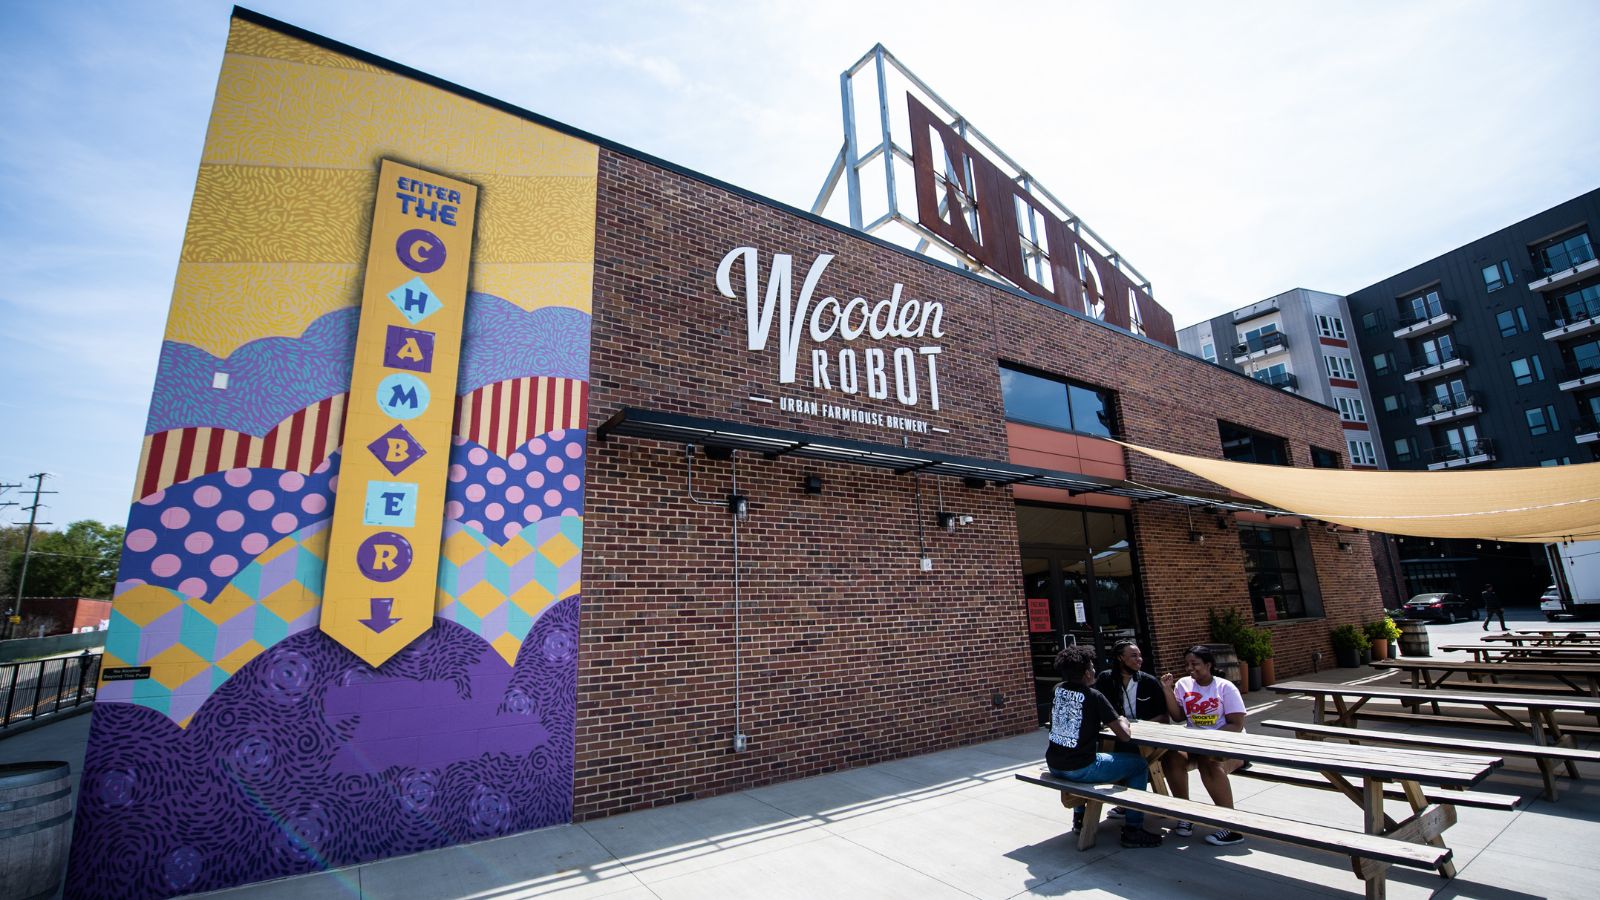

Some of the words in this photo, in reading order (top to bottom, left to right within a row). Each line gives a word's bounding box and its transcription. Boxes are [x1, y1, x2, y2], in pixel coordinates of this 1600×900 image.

[396, 175, 462, 206] ENTER
[396, 193, 457, 227] THE
[715, 246, 945, 384] Wooden
[812, 346, 942, 411] ROBOT
[779, 396, 819, 417] URBAN
[821, 403, 884, 427] FARMHOUSE
[886, 415, 928, 435] BREWERY
